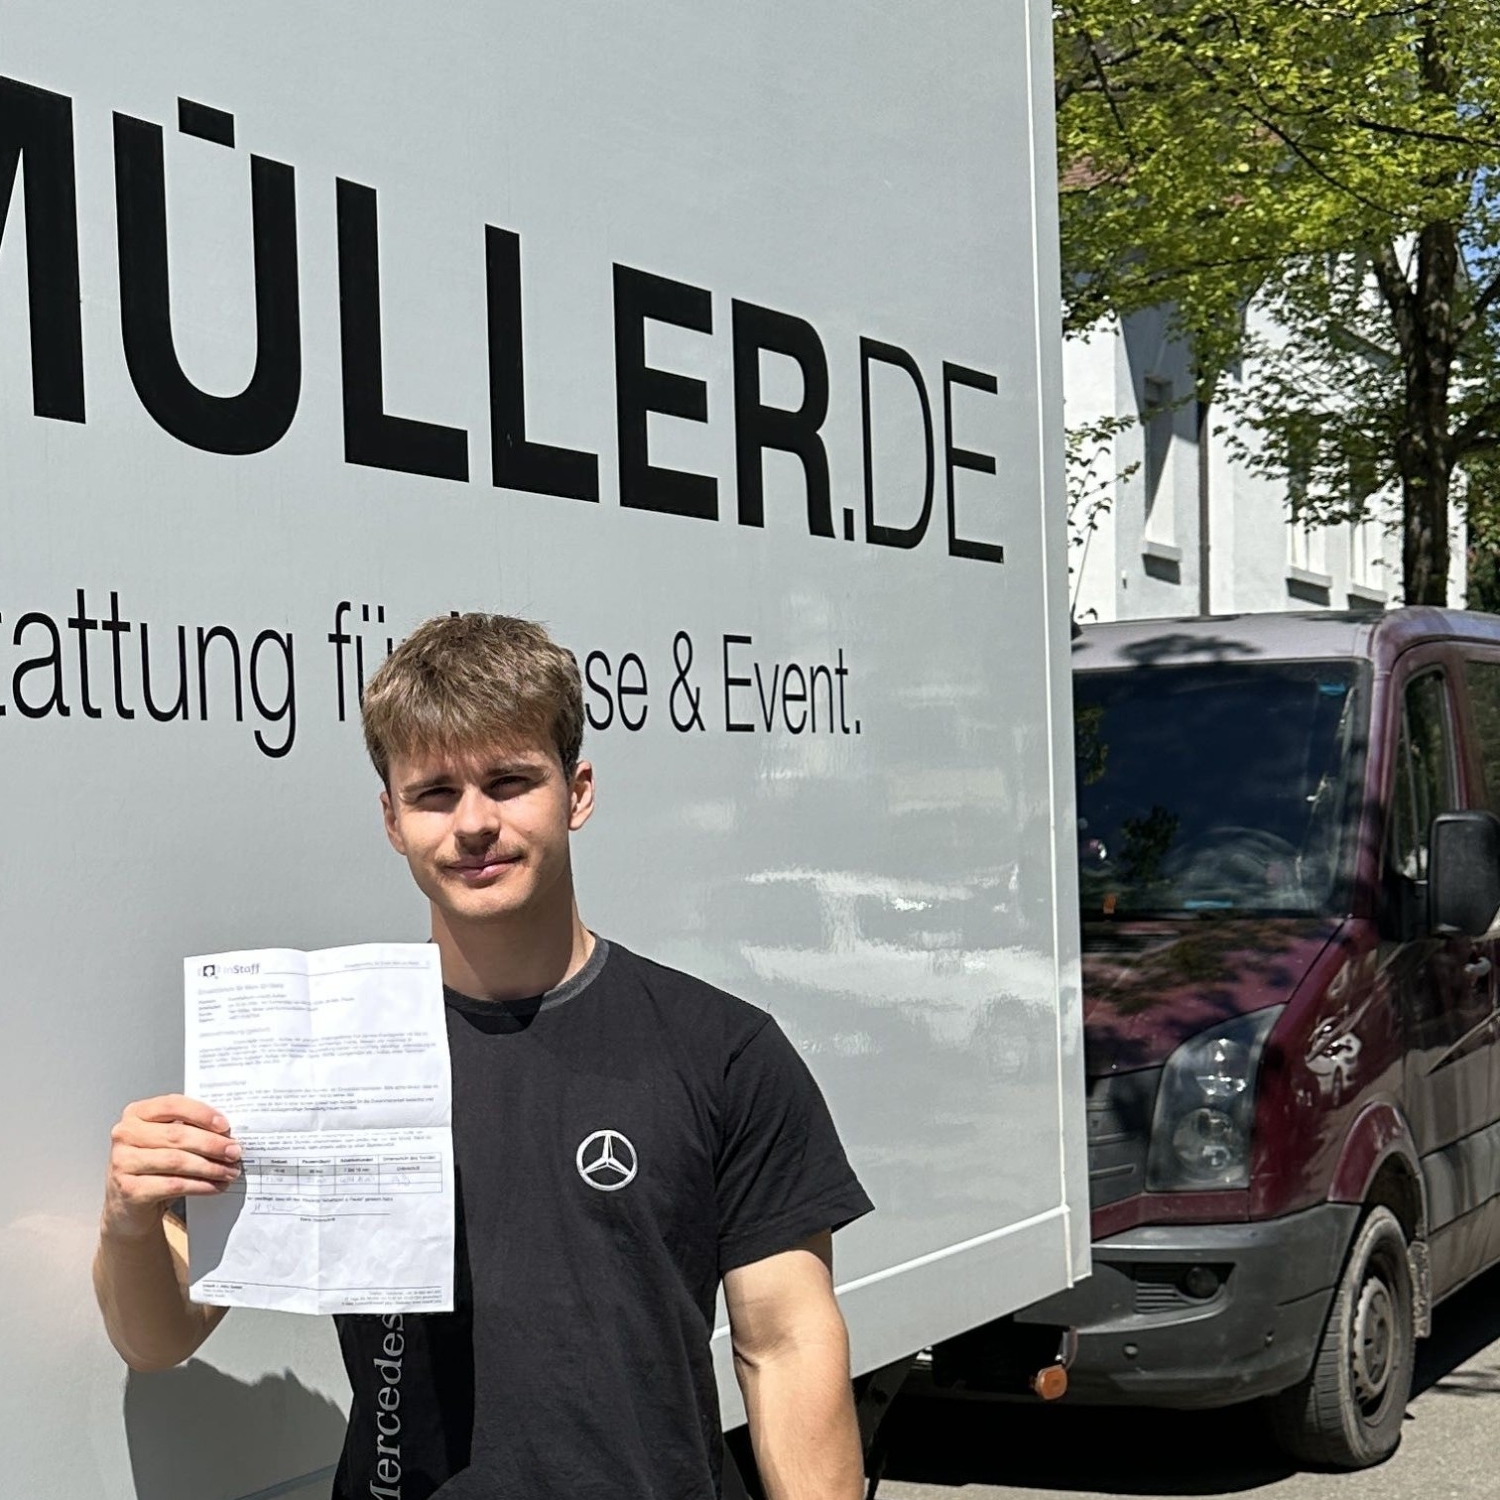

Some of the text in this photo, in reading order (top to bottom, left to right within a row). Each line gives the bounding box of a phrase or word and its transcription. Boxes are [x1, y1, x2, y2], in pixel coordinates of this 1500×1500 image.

[328, 600, 406, 722] fü
[670, 630, 706, 732] &
[724, 635, 862, 735] Event.
